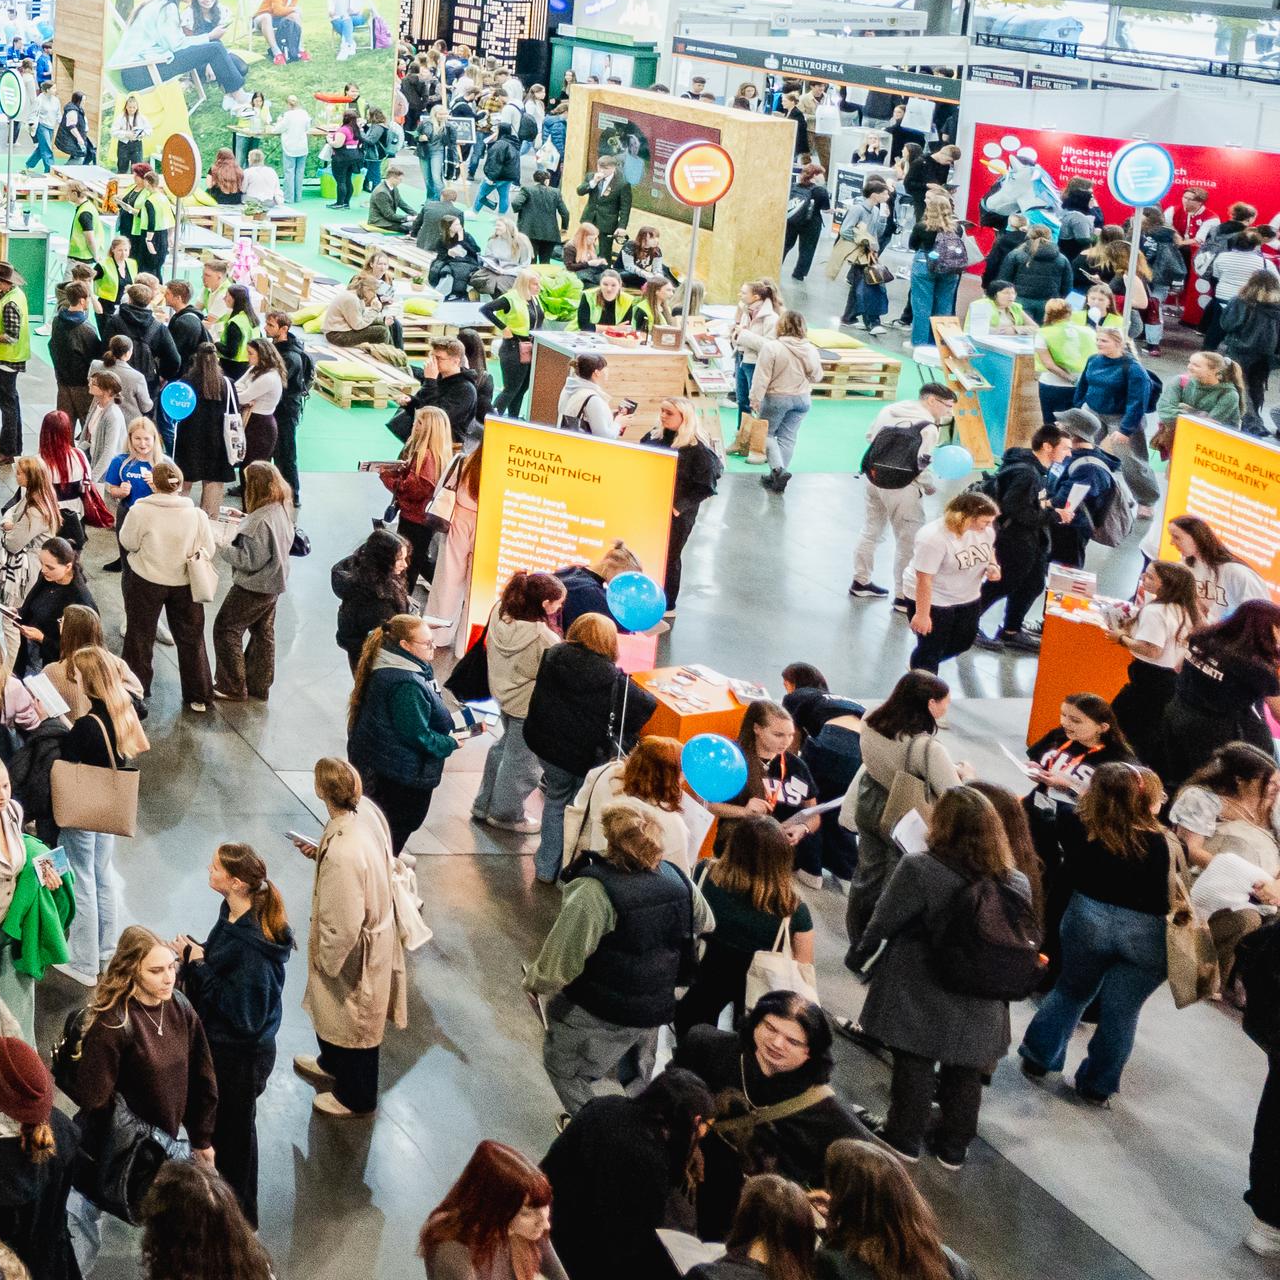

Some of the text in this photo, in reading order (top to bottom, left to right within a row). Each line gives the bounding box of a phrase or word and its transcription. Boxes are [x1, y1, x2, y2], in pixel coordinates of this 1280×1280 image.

[782, 57, 844, 74] PANEVROPSKÁ
[1062, 146, 1113, 160] Jihočeská
[1061, 165, 1108, 176] Universit
[1172, 178, 1216, 188] ohemia
[509, 444, 562, 463] FAKULTA
[1196, 444, 1240, 467] FAKULTA
[507, 468, 548, 485] STUDIÍ
[508, 456, 601, 484] HUMANITNÍCH
[1194, 456, 1268, 491] INFORMATIKY
